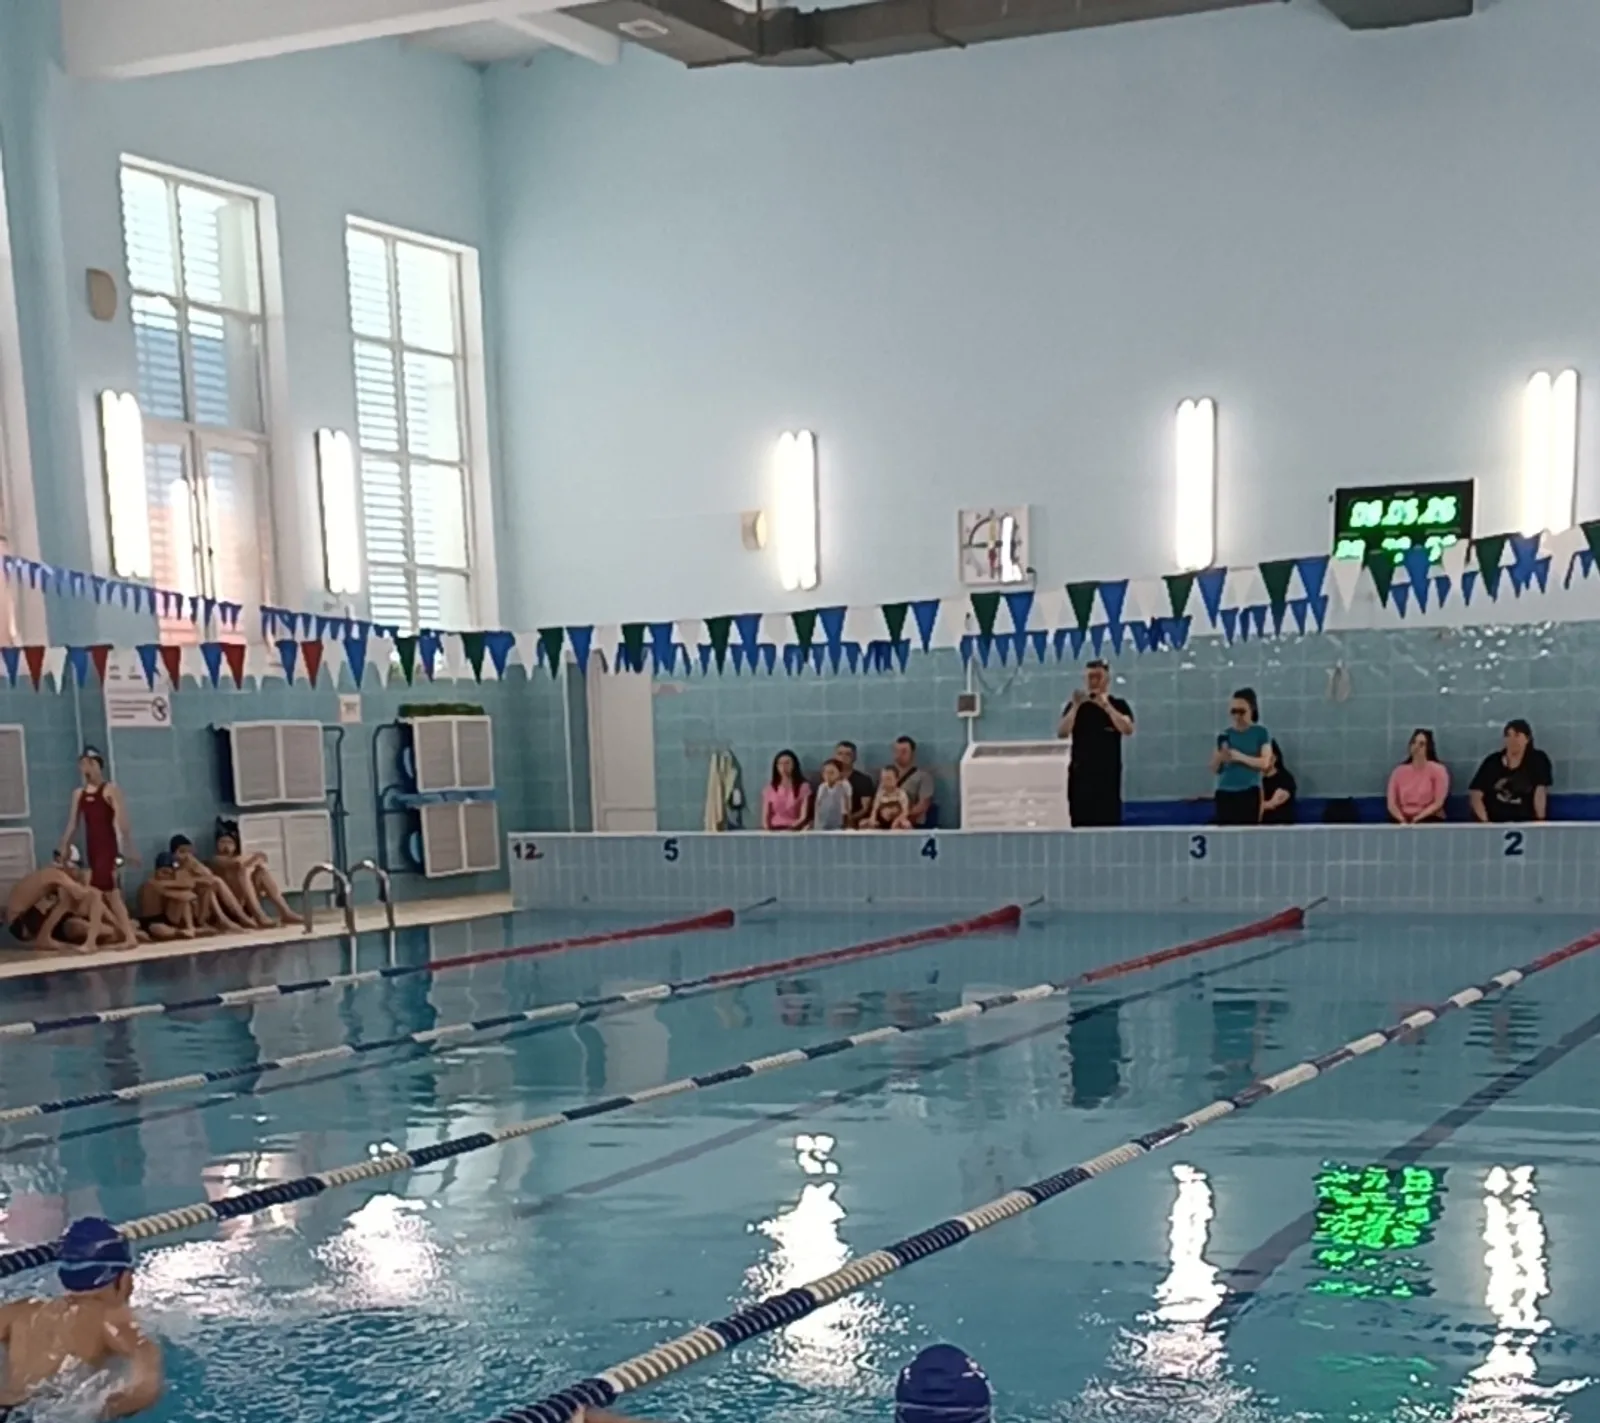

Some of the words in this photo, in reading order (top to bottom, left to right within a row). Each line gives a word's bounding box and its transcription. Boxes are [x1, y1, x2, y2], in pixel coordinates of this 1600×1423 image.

[664, 838, 679, 861] 5
[921, 837, 938, 860] 4
[1189, 835, 1206, 859] 3
[1504, 831, 1523, 856] 2
